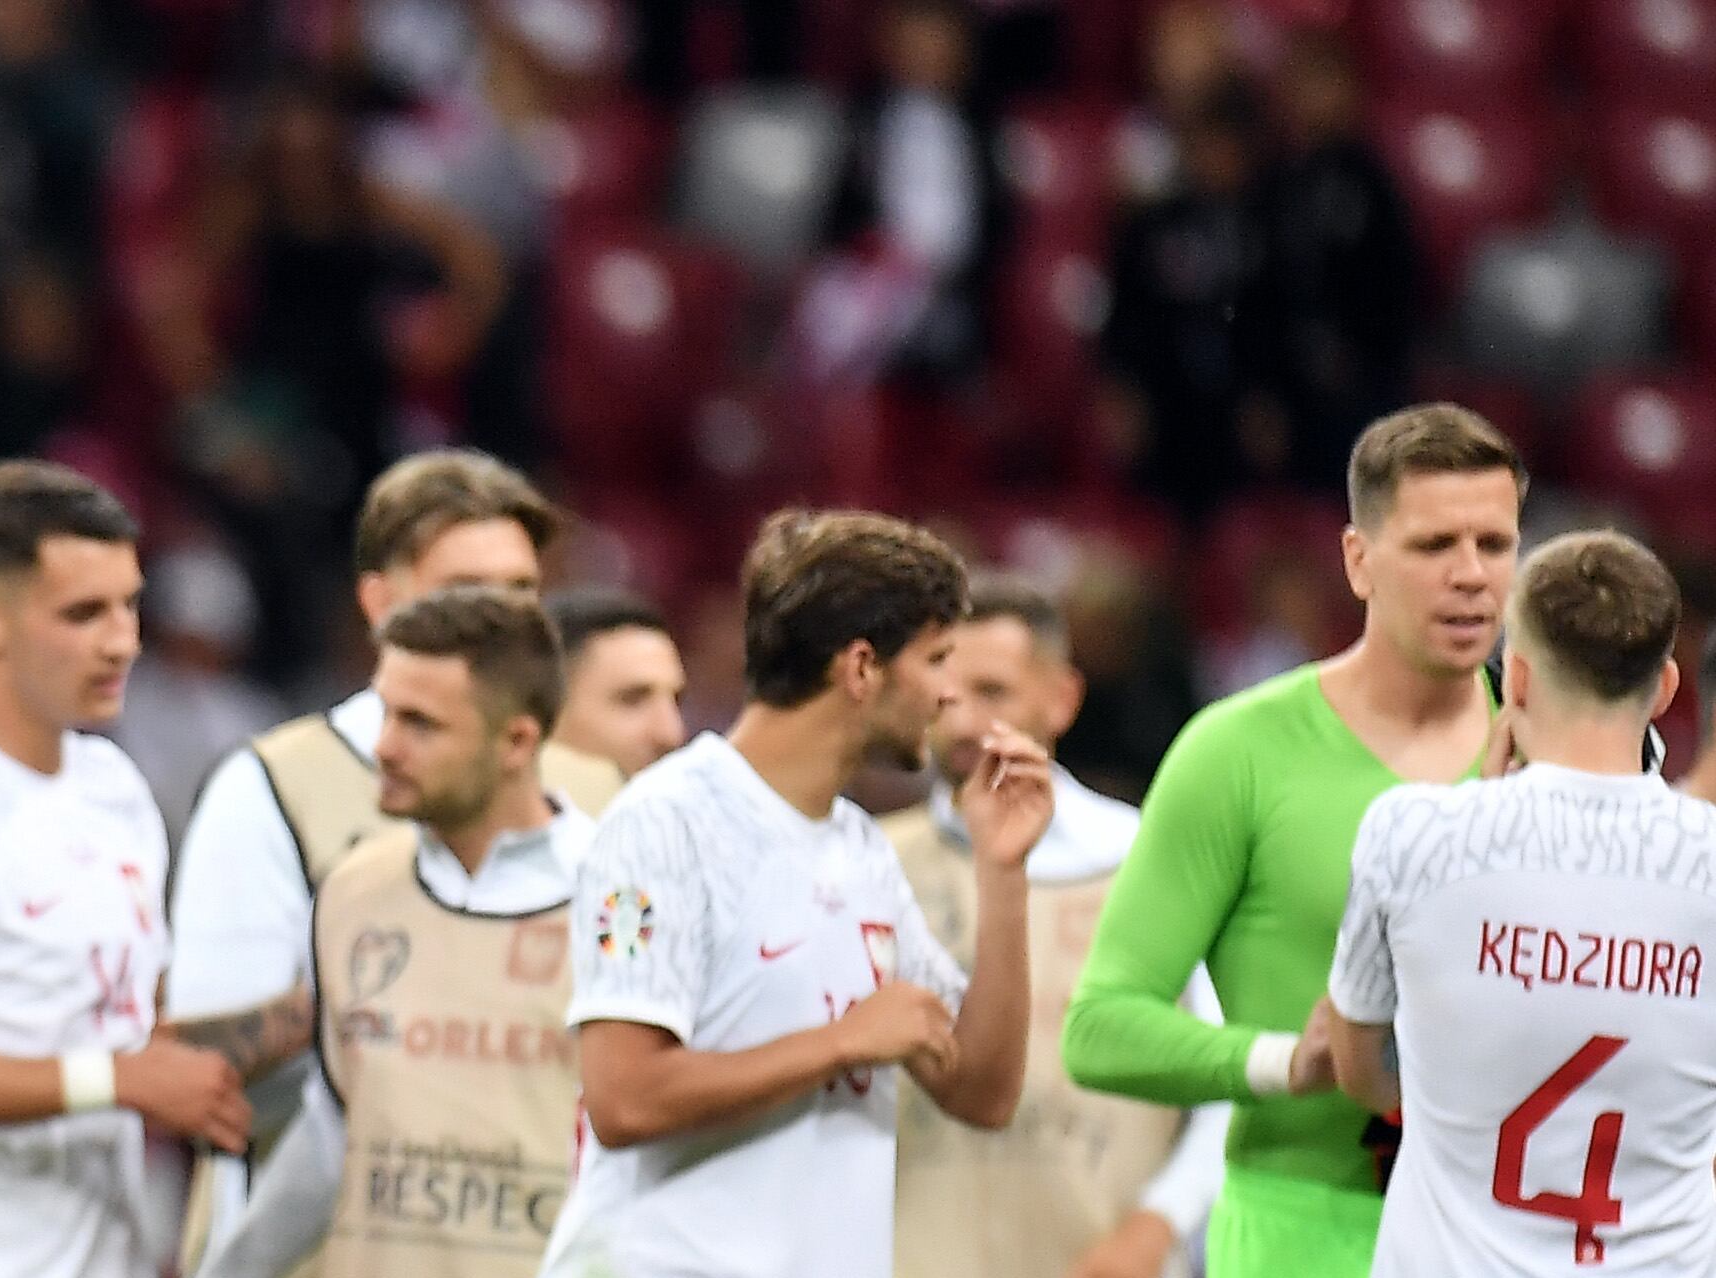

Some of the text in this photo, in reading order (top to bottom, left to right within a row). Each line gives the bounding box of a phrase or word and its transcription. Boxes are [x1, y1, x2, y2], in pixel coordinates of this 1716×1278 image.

[1478, 919, 1702, 998] KĘDZIORA
[1492, 1034, 1629, 1264] 4
[367, 1167, 561, 1237] RESPEC
